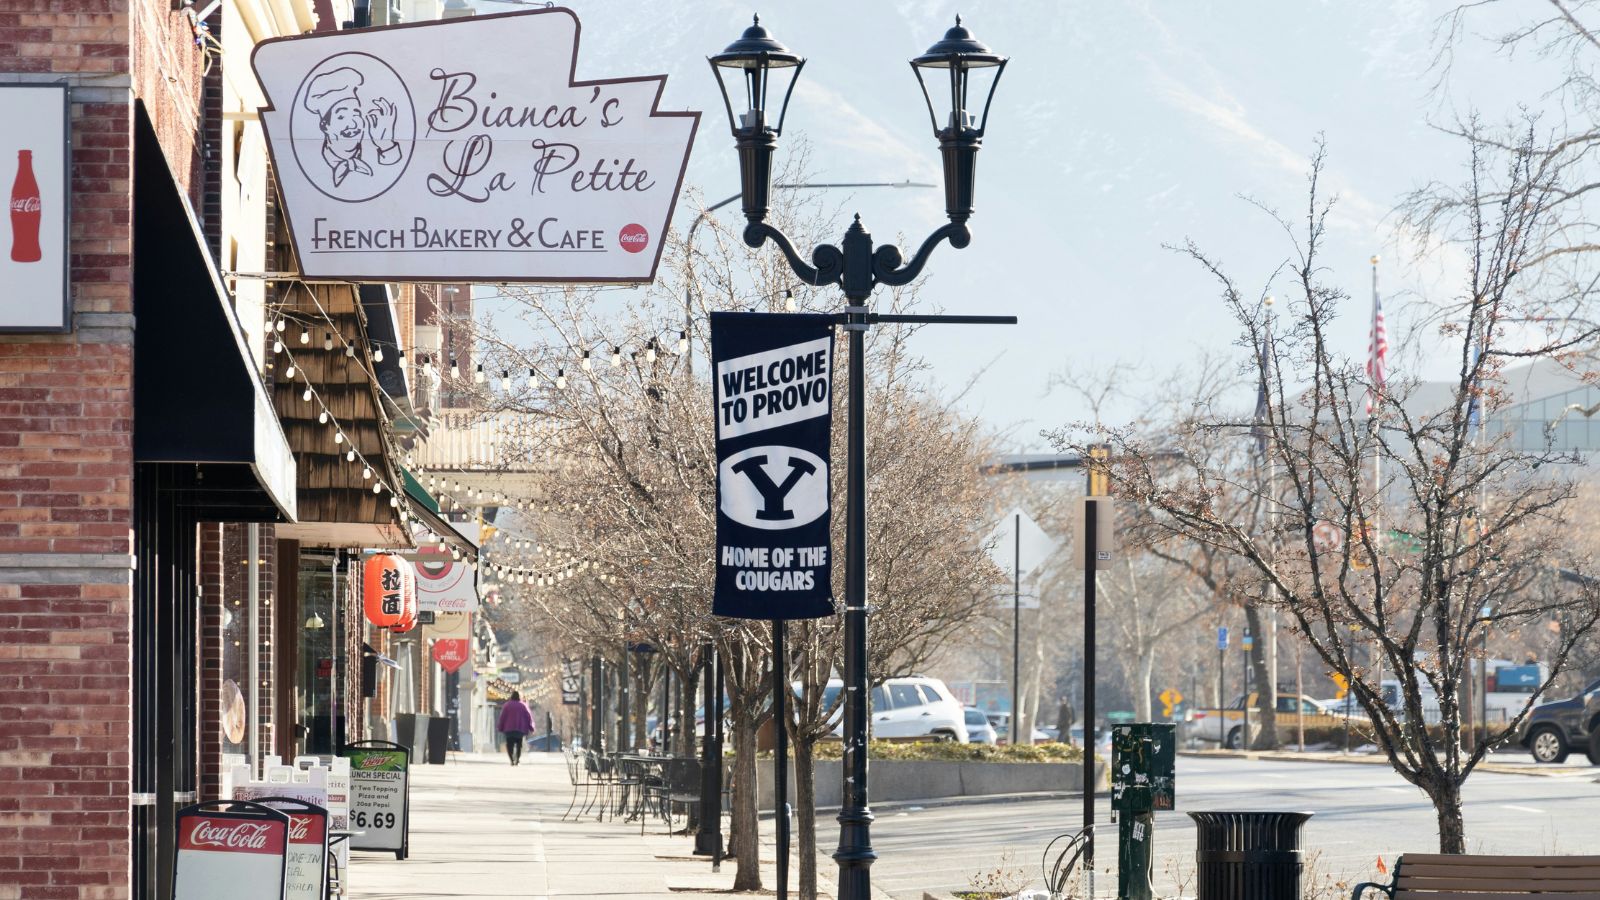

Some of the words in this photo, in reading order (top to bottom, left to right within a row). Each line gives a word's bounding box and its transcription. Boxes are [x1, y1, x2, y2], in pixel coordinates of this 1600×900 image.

[425, 67, 624, 139] Bianca's
[426, 134, 516, 203] La
[531, 138, 657, 196] Petite
[311, 217, 405, 250] FRENCH
[410, 216, 502, 249] BAKERY
[507, 218, 535, 249] &
[538, 218, 605, 250] CAFE
[619, 231, 647, 245] Coca-Cola
[722, 349, 827, 398] WELCOME
[721, 396, 747, 426] TO
[752, 377, 827, 419] PROVO
[731, 454, 817, 521] Y
[722, 545, 767, 568] HOME
[771, 546, 794, 568] OF
[797, 546, 827, 567] THE
[735, 570, 815, 591] COUGARS
[350, 771, 371, 779] UNCH
[373, 771, 401, 780] SPECIAL
[373, 785, 398, 793] Topping
[349, 808, 395, 829] $6.69
[190, 820, 272, 849] Coca-Cola
